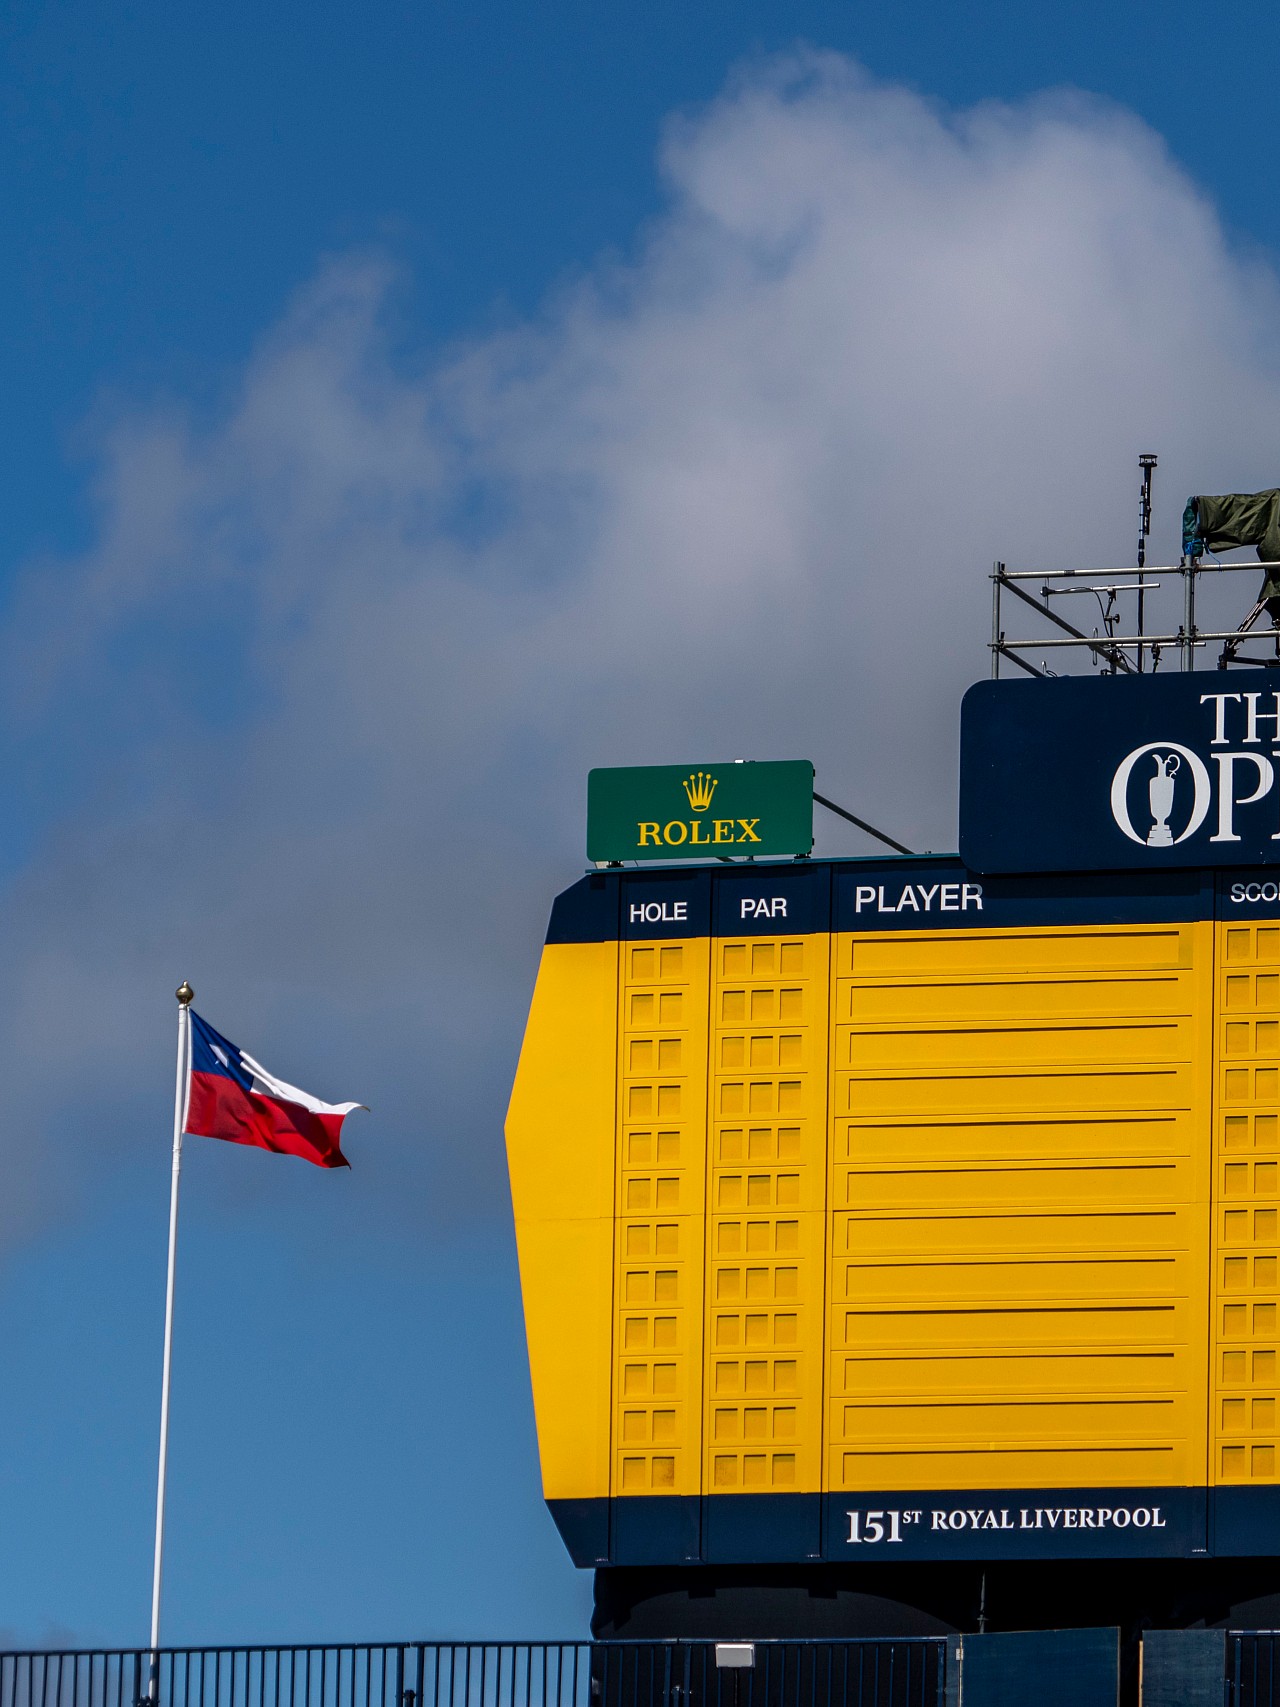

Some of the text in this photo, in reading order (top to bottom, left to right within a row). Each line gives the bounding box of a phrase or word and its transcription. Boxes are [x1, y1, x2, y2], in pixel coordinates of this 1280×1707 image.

[636, 818, 762, 847] ROLEX
[740, 897, 787, 919] PAR
[855, 883, 984, 913] PLAYER
[629, 902, 688, 923] HOLE
[931, 1510, 1014, 1530] ROYAL
[1019, 1507, 1166, 1528] LIVERPOOL
